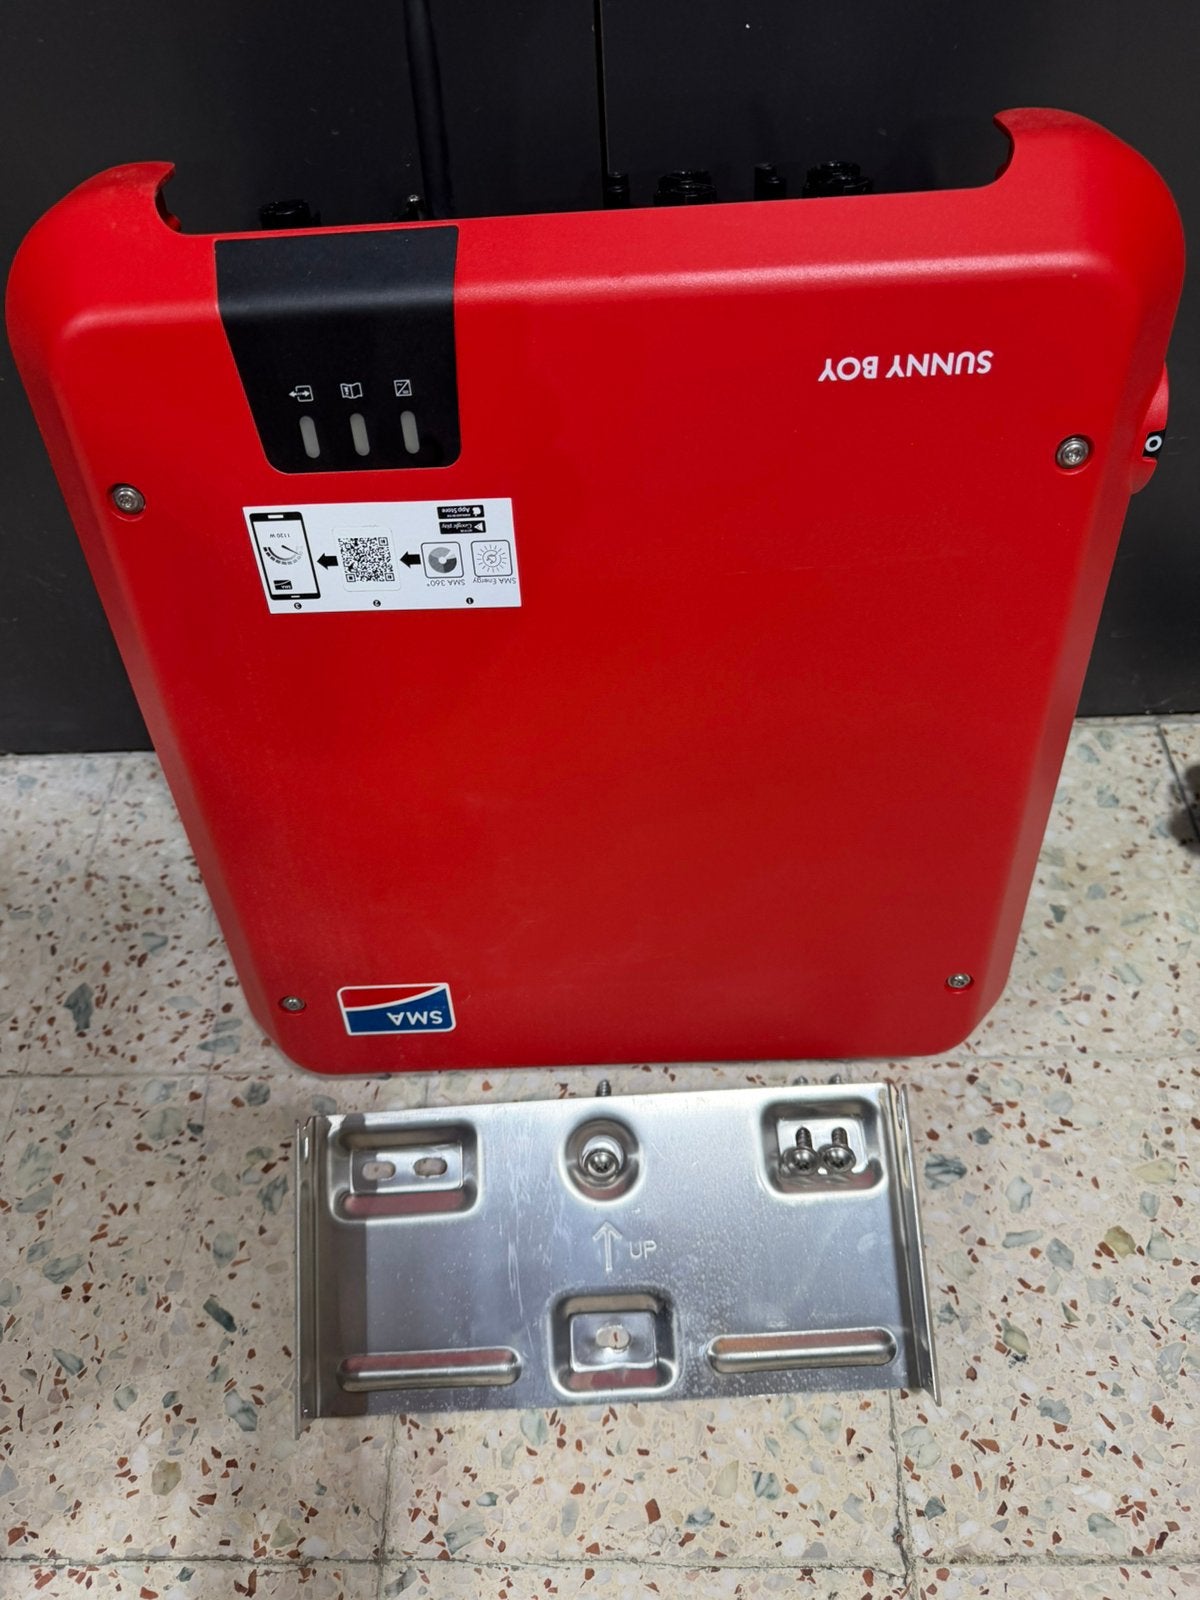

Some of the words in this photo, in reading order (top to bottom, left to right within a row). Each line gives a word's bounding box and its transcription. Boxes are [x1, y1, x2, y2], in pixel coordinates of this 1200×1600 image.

[817, 355, 879, 382] BOY
[885, 350, 994, 378] SUNNY
[453, 522, 473, 530] Google
[472, 577, 497, 585] Energy
[386, 1010, 443, 1026] SMA
[629, 1240, 657, 1259] UP
